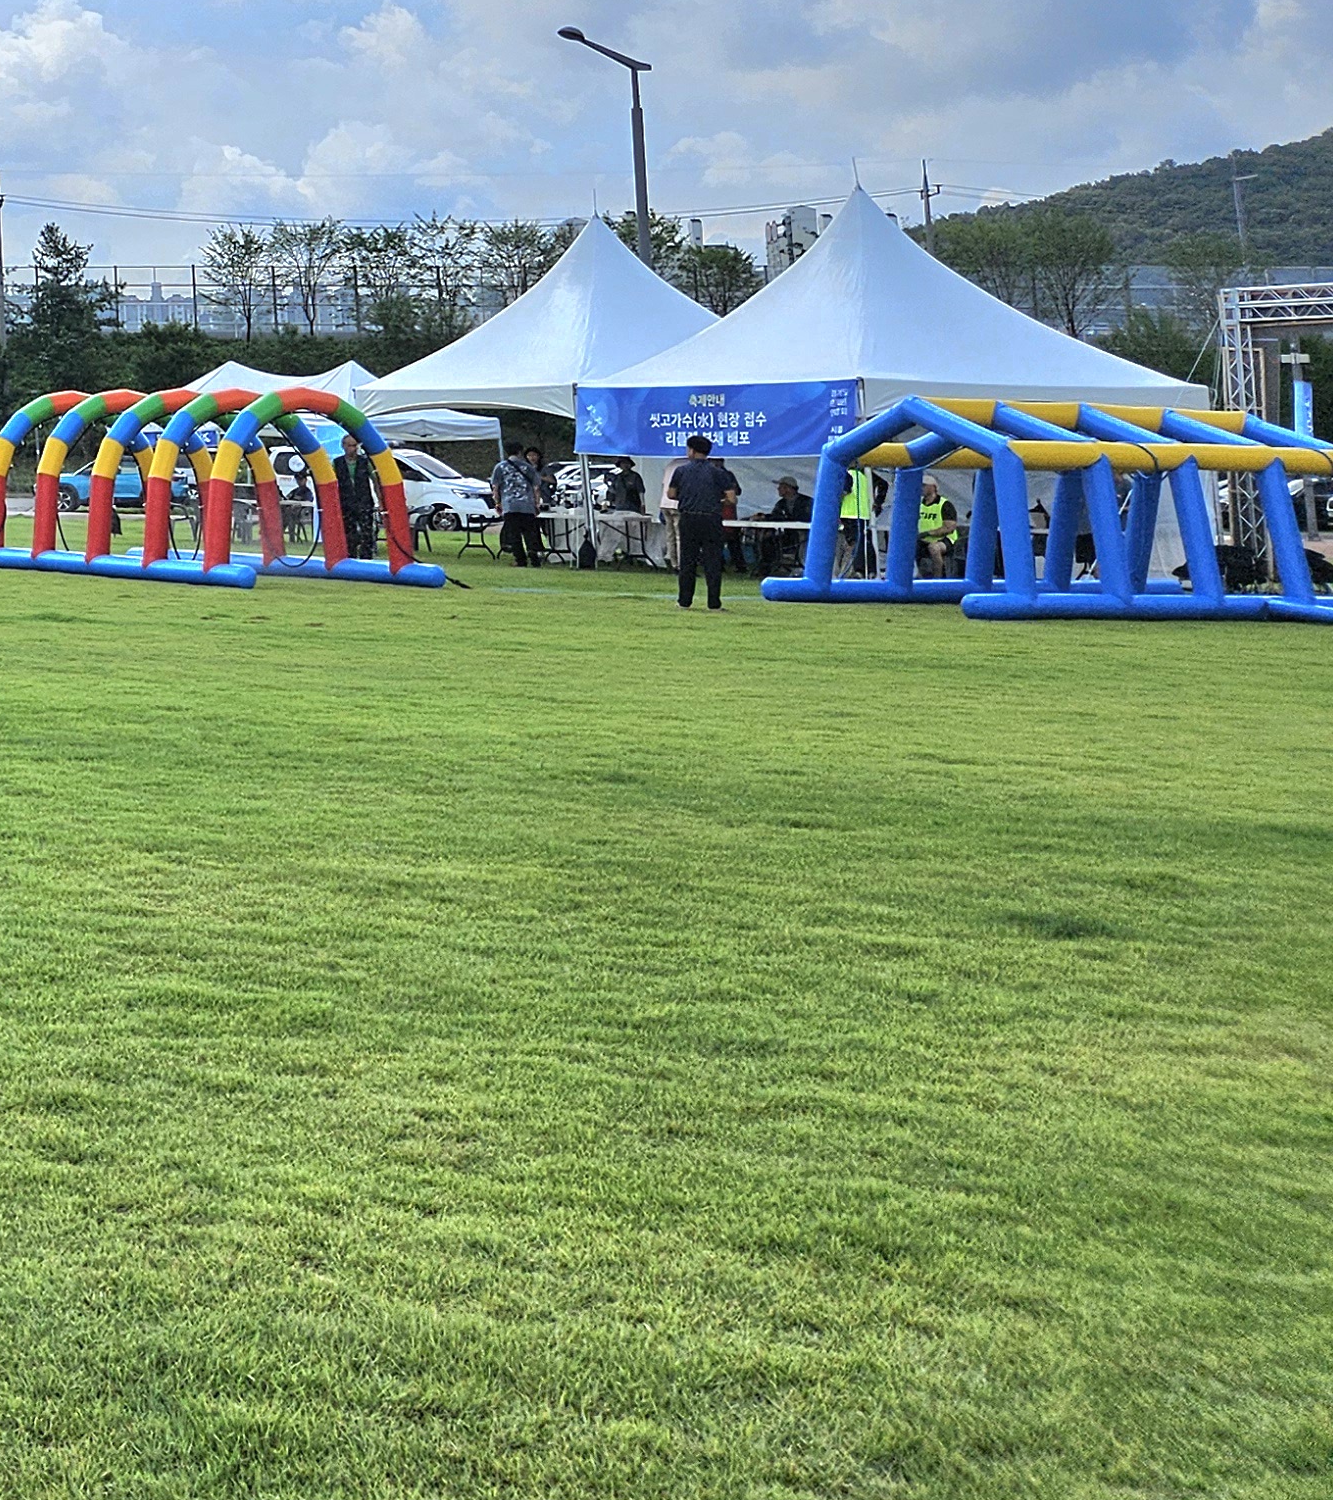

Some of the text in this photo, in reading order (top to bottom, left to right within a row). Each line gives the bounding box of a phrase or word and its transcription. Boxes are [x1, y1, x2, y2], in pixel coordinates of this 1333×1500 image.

[649, 411, 767, 428] 씻고가수(水) 현장 접수
[727, 430, 751, 446] 배포
